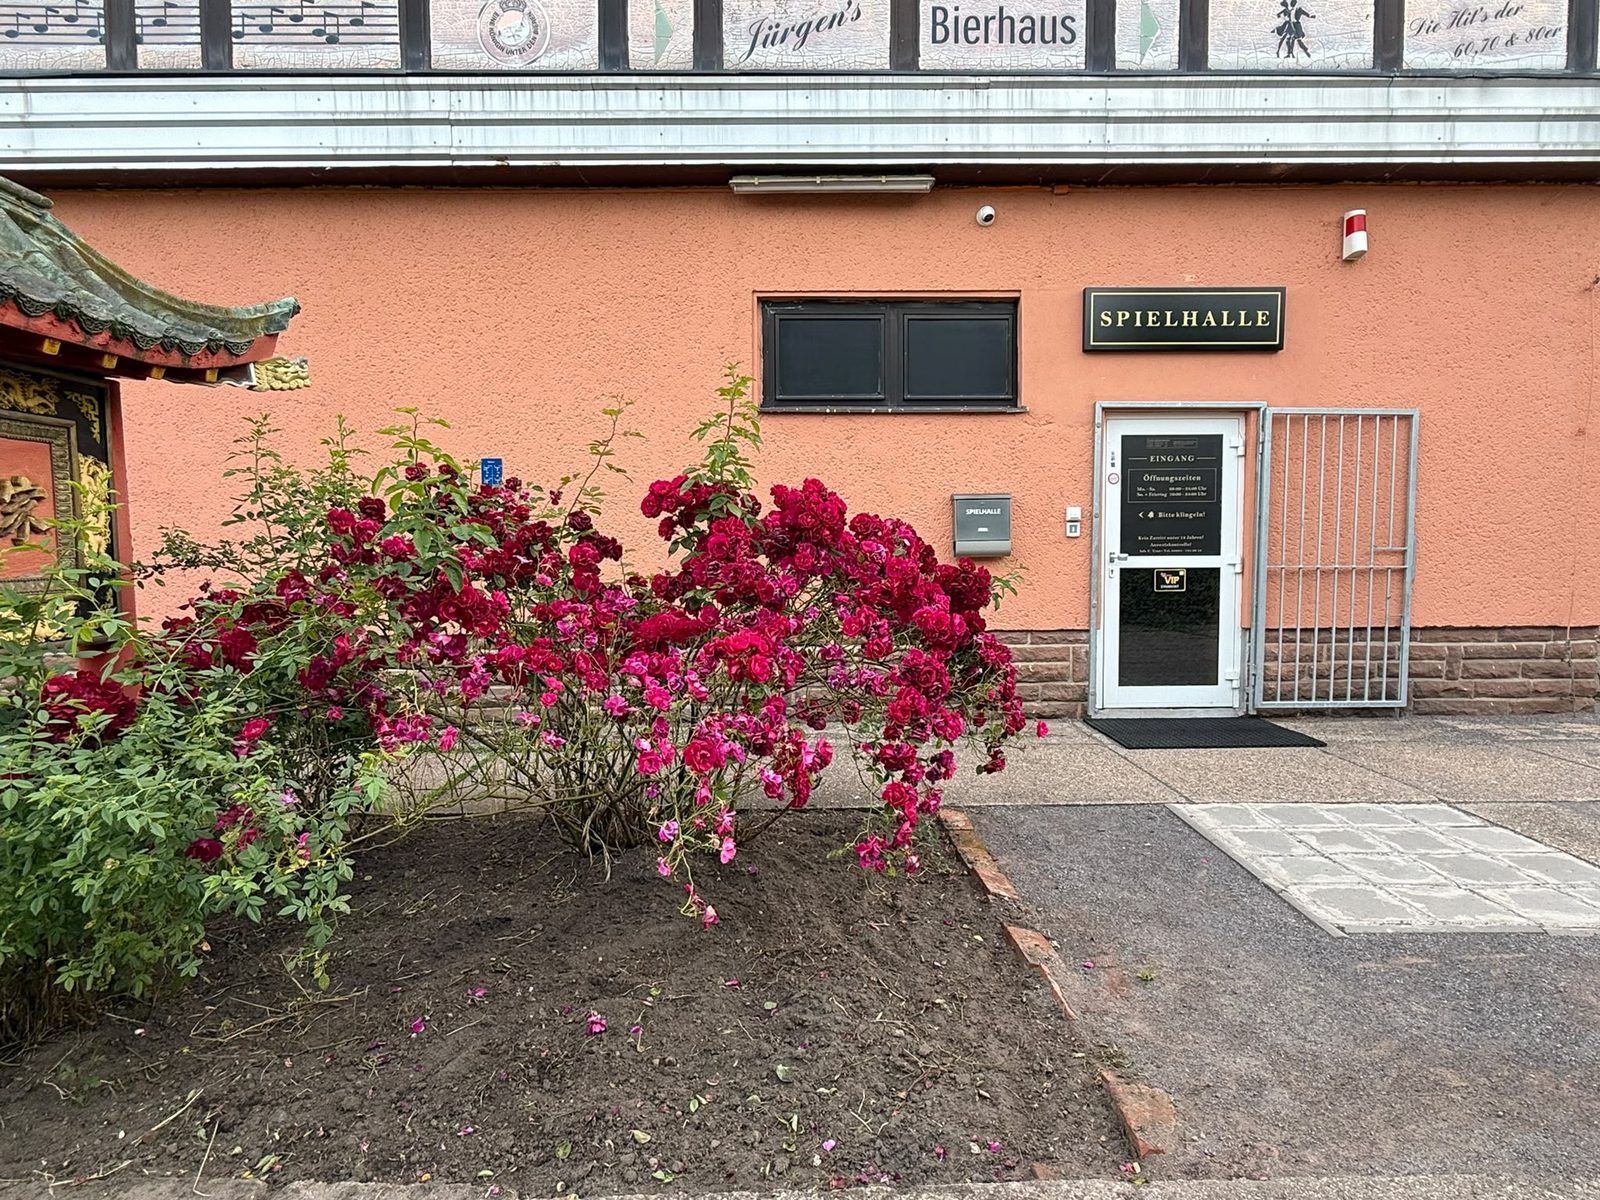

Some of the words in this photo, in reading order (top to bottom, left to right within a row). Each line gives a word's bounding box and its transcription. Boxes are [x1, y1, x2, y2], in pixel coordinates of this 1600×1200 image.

[931, 6, 1077, 45] Bierhaus
[1409, 17, 1442, 36] Die
[1494, 1, 1524, 20] der
[739, 1, 861, 62] Jürgen's
[1504, 33, 1519, 47] &
[1524, 26, 1562, 42] 80er
[1100, 310, 1271, 327] SPIELHALLE
[1143, 473, 1202, 483] Öffnungszeiten
[1176, 511, 1206, 519] klingeln!
[1164, 576, 1180, 585] VIP
